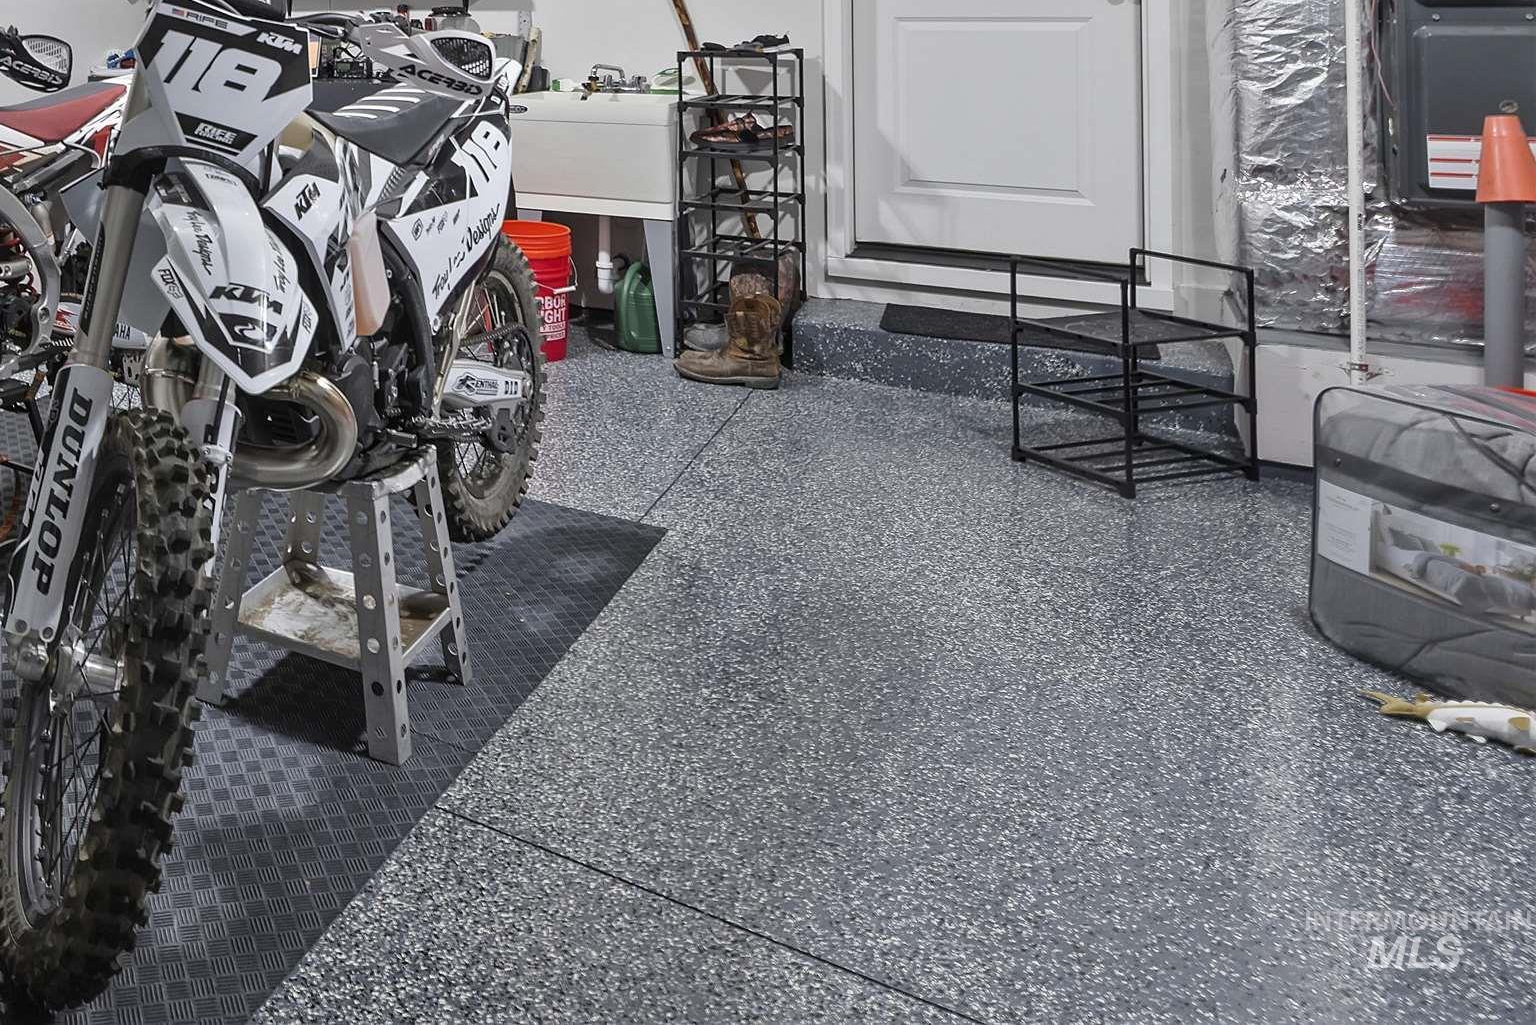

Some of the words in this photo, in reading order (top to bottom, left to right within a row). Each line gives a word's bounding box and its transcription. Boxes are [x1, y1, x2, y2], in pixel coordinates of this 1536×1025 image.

[185, 10, 229, 30] RIFE
[257, 31, 303, 55] KTM
[154, 29, 283, 100] 118
[451, 120, 511, 183] 118
[293, 181, 321, 221] KTM
[209, 282, 284, 316] KTM
[31, 386, 94, 597] DUNLOP
